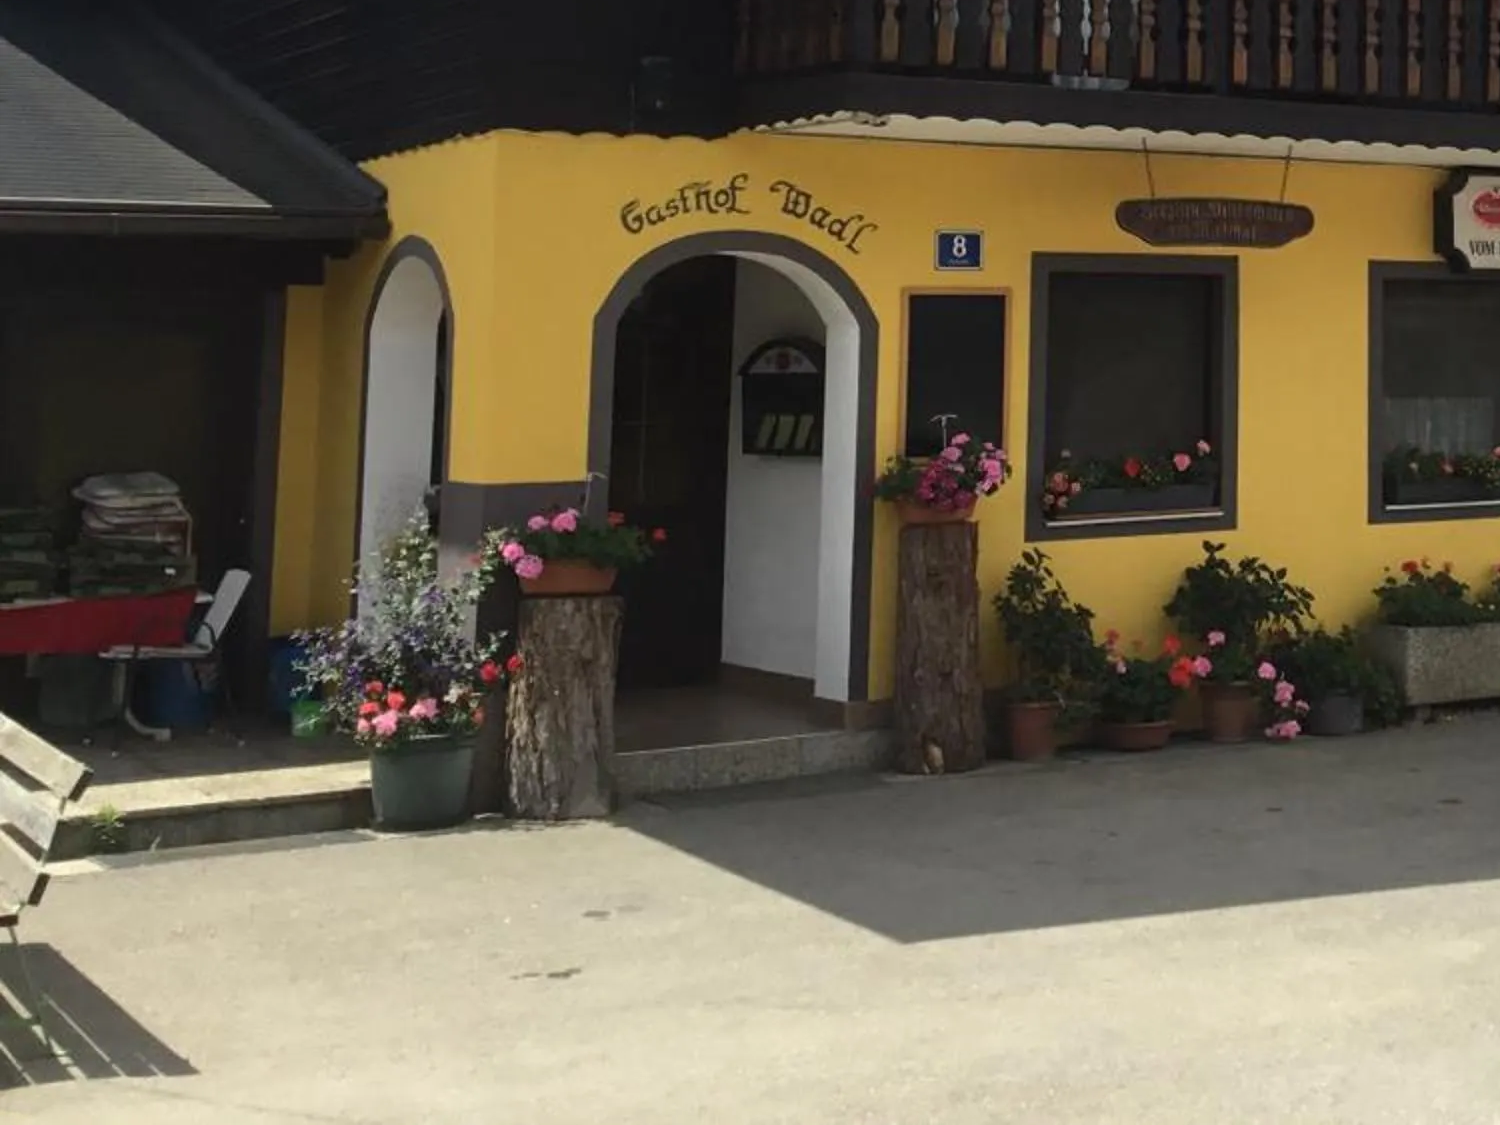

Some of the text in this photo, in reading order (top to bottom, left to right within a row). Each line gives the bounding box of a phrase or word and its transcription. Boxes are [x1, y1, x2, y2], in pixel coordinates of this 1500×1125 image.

[620, 173, 878, 255] Gasthof Wadl
[953, 235, 967, 258] 8
[1469, 240, 1496, 256] VOM
